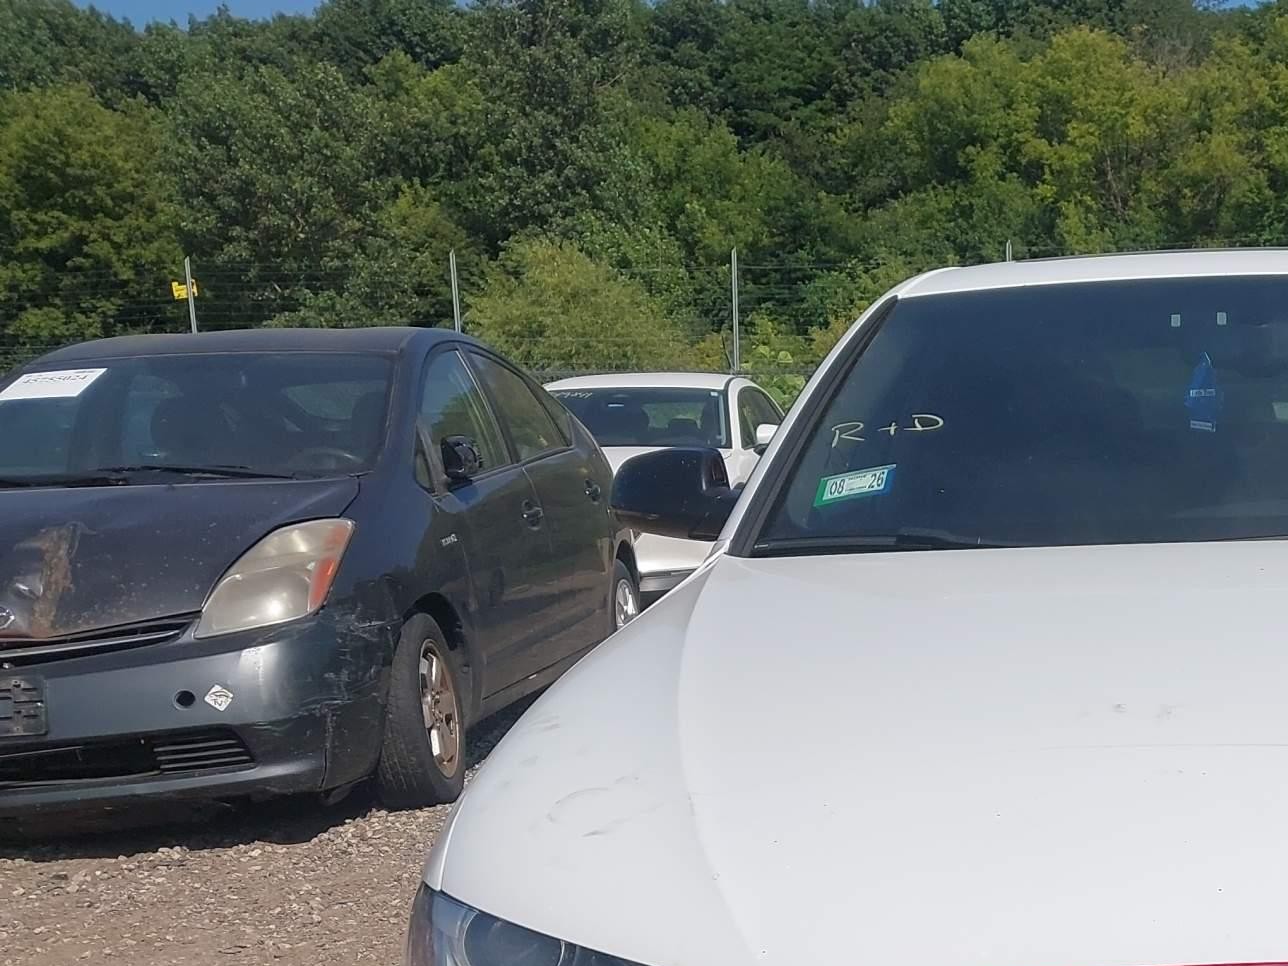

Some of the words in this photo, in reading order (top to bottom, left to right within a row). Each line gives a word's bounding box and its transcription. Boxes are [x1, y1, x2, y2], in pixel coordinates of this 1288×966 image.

[831, 421, 865, 448] R
[904, 414, 944, 431] D
[829, 478, 846, 496] 08
[867, 471, 885, 489] 26
